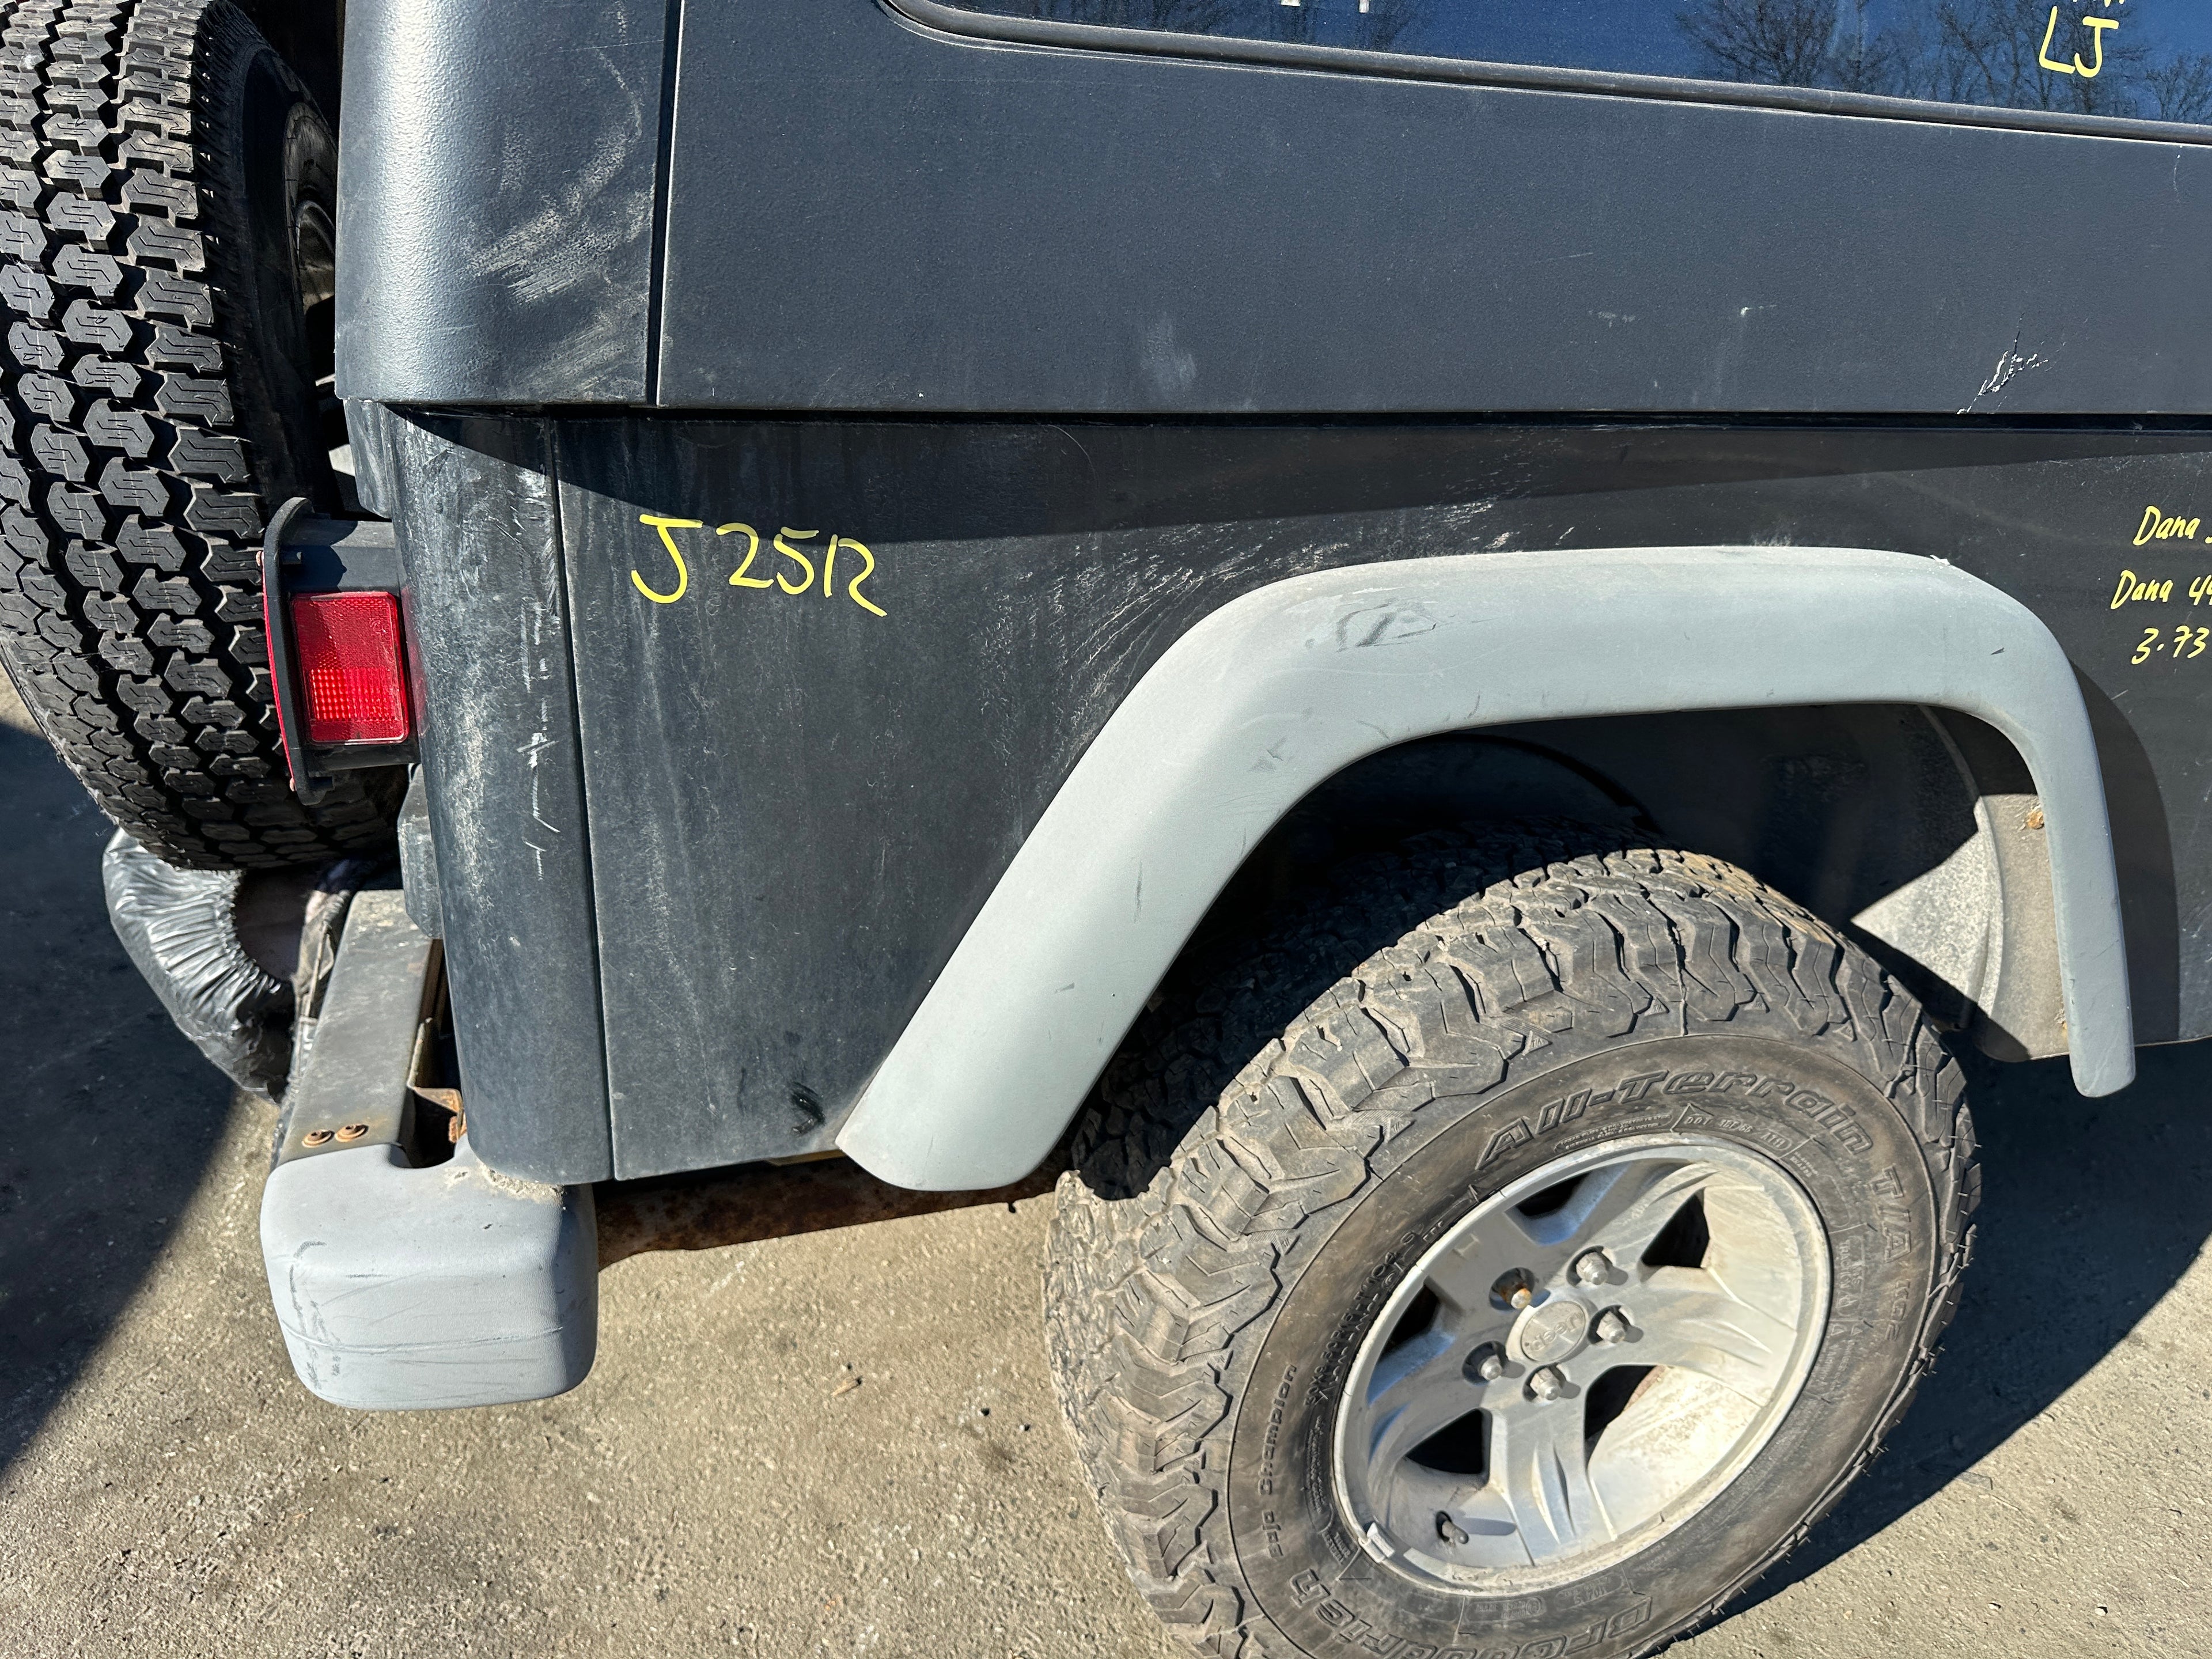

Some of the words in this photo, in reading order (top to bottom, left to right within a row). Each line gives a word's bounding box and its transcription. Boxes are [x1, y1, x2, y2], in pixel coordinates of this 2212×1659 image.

[2039, 6, 2119, 78] LJ
[2133, 505, 2200, 546] Dana
[2111, 569, 2173, 609] Dana
[2131, 624, 2210, 665] 3.73
[1475, 1070, 1873, 1170] All-Terrain
[1530, 1312, 1584, 1351] Jeep
[1257, 1363, 1297, 1497] Champion
